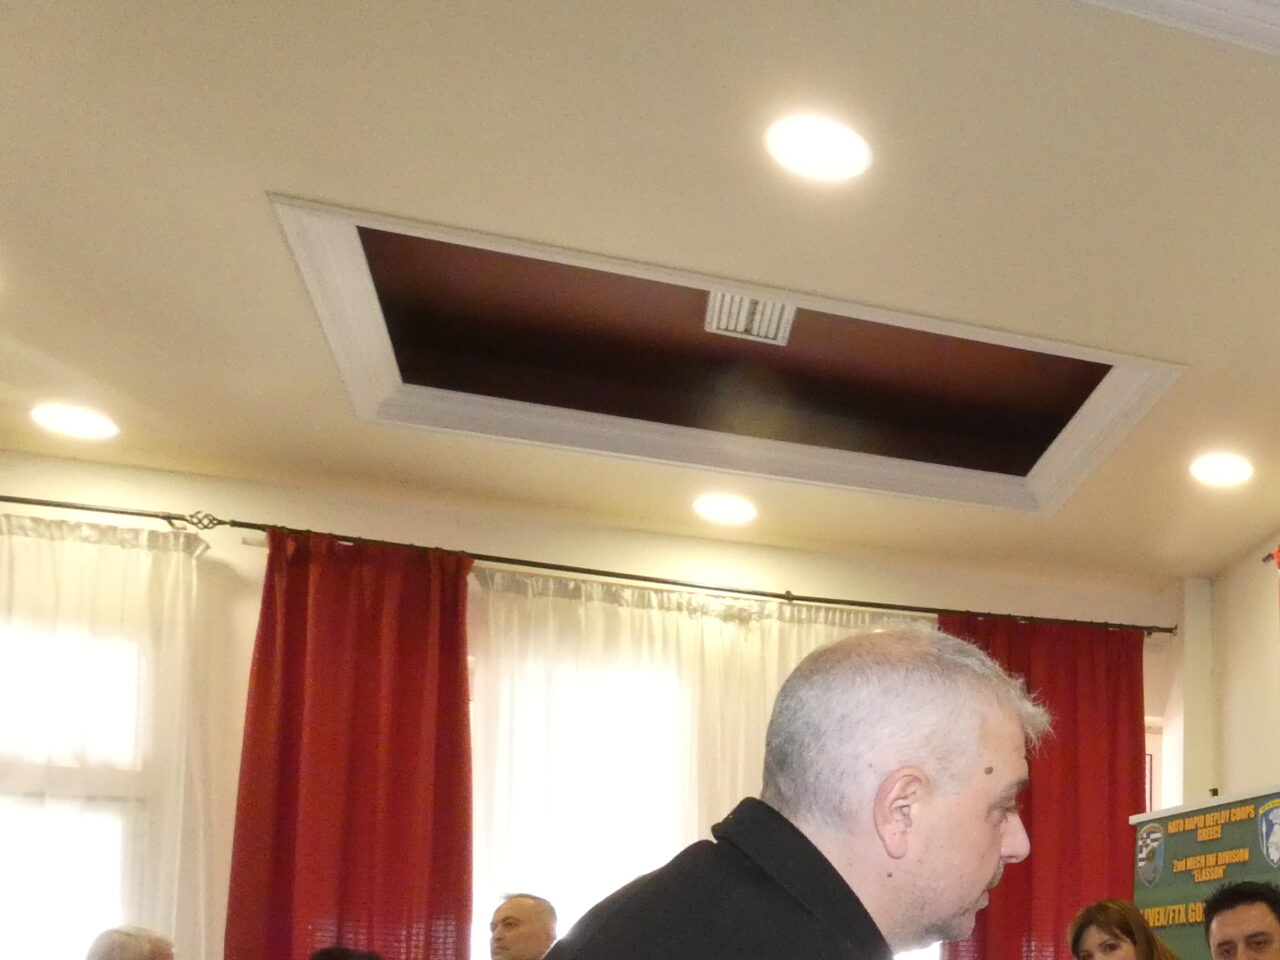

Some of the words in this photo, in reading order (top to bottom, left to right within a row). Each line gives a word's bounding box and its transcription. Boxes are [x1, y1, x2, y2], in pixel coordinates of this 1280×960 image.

[1205, 809, 1230, 826] DEPLOY
[1231, 805, 1255, 821] CORPS
[1197, 825, 1222, 841] GREECE
[1187, 855, 1205, 870] MECH
[1218, 848, 1249, 865] DIVISION
[1140, 904, 1186, 927] IVEX/FTX
[1188, 902, 1206, 923] GO
